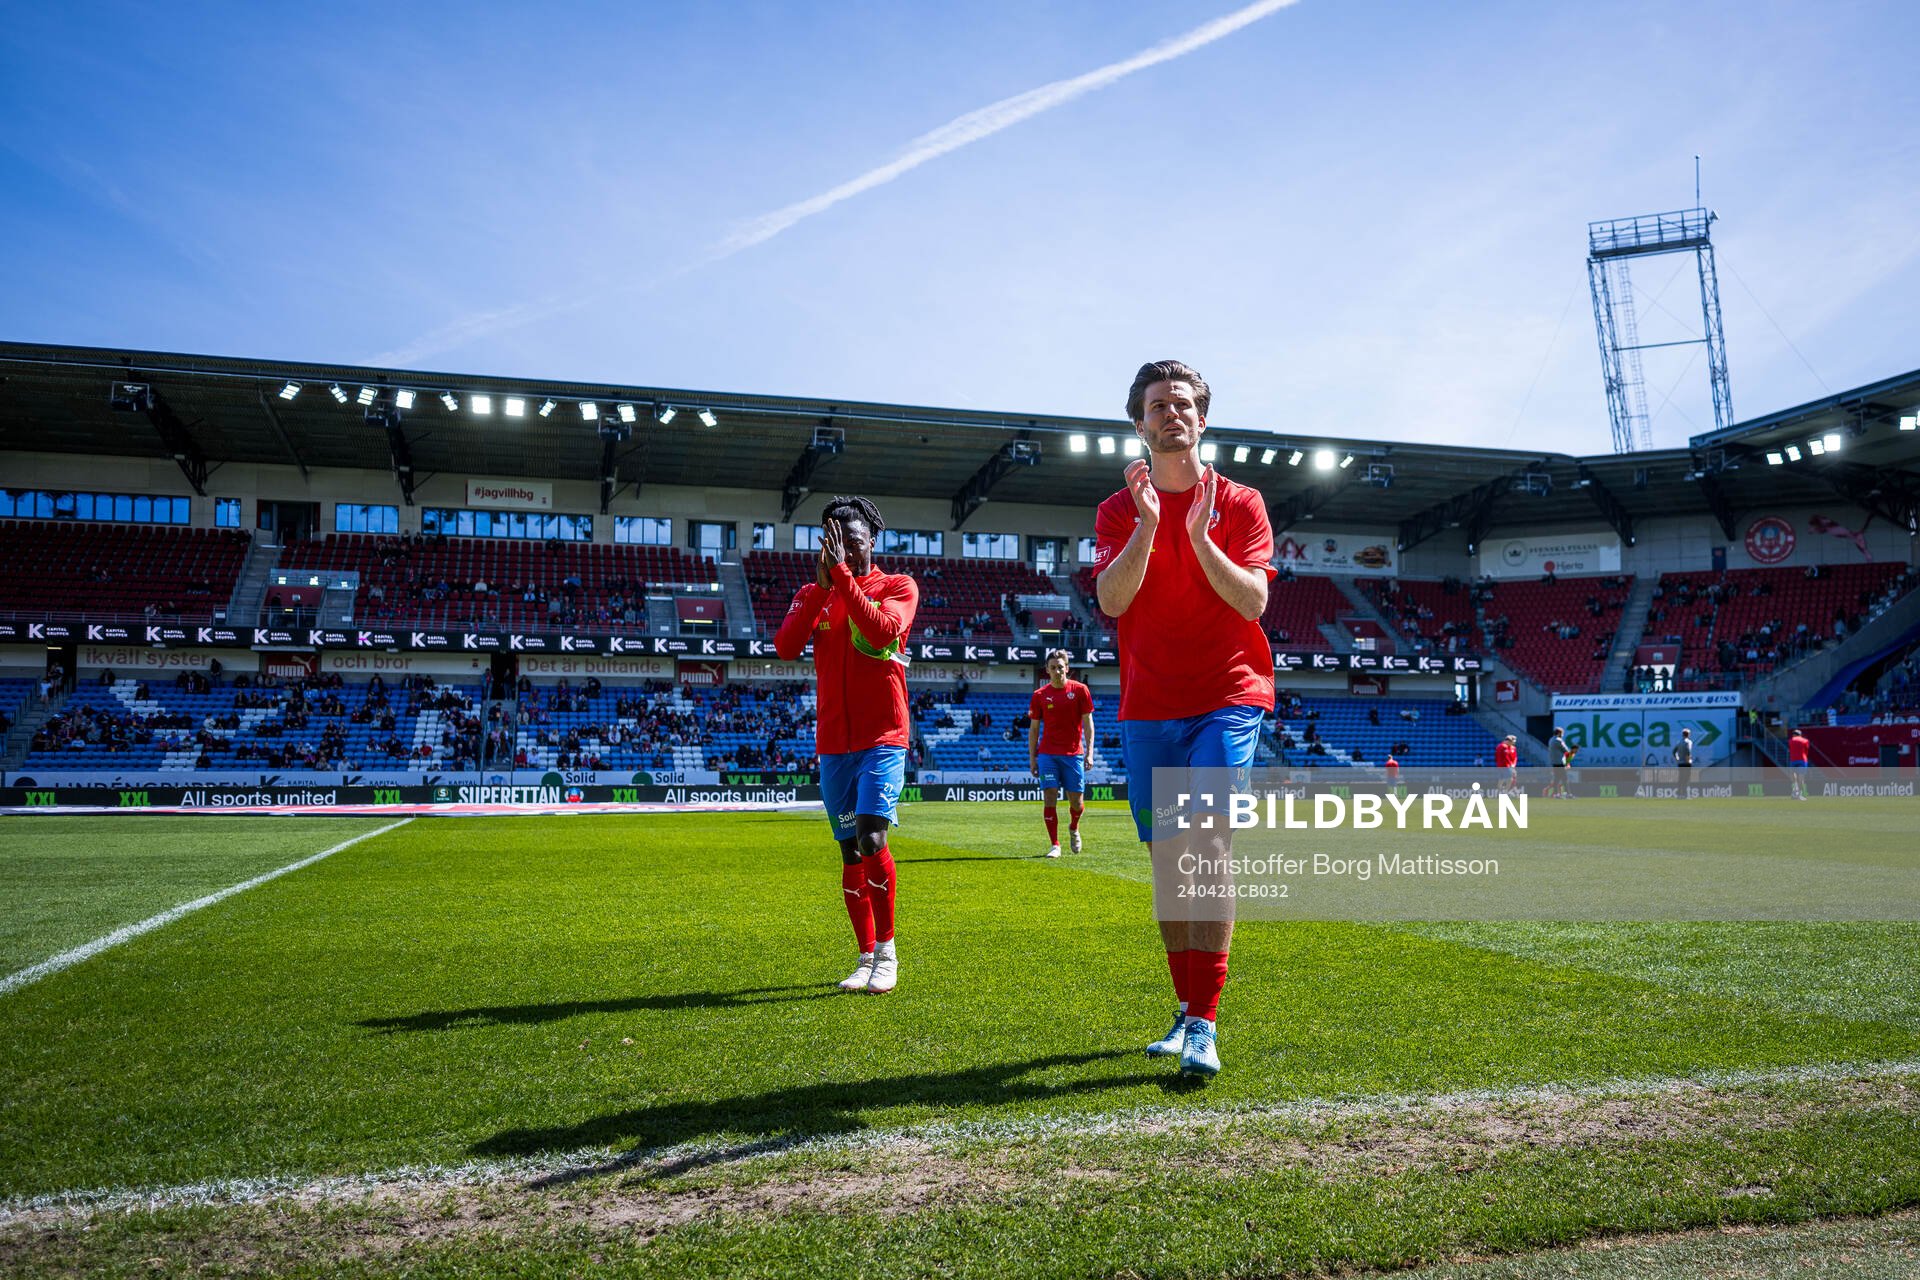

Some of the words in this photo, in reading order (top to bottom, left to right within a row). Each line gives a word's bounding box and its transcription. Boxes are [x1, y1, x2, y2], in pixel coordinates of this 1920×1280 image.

[475, 486, 534, 502] #jagvillhbg
[29, 624, 44, 638] K
[88, 625, 104, 640] K
[146, 626, 161, 641] K
[198, 627, 213, 642] K
[254, 629, 268, 643] K
[309, 630, 324, 645] K
[358, 631, 372, 646] K
[412, 632, 426, 647] K
[464, 634, 478, 648] K
[510, 635, 524, 649] K
[561, 636, 574, 650] K
[610, 637, 624, 652] K
[654, 638, 668, 652] K
[703, 640, 716, 654] K
[750, 640, 762, 654] K
[922, 645, 934, 658] K
[965, 646, 977, 659] K
[1008, 647, 1020, 660] K
[86, 648, 139, 664] ikväll
[146, 650, 208, 668] syster
[333, 654, 366, 669] och
[374, 655, 413, 670] bror
[1087, 648, 1099, 662] K
[1276, 654, 1287, 666] K
[1313, 654, 1324, 667] K
[1350, 655, 1361, 668] K
[1383, 656, 1394, 668] K
[527, 658, 556, 672] Det
[562, 659, 580, 673] är
[585, 659, 661, 673] bultande
[1419, 657, 1430, 669] K
[1454, 657, 1465, 670] K
[680, 672, 712, 683] PUMA
[1555, 698, 1610, 706] KLIPPANS
[1646, 696, 1703, 704] KLIPPANS
[1566, 714, 1671, 748] akea
[565, 772, 595, 783] Solid
[655, 772, 685, 783] Solid
[373, 789, 403, 804] XXL
[458, 786, 560, 804] SUPERETTAN
[613, 789, 639, 802] XXL
[665, 789, 685, 803] All
[690, 790, 741, 803] sports
[746, 788, 796, 802] united
[900, 788, 923, 801] XXL
[945, 788, 964, 801] All
[968, 789, 1014, 802] sports
[1091, 787, 1115, 800] XXL
[1600, 785, 1618, 797] XXL
[1702, 784, 1732, 797] united
[1822, 782, 1838, 796] All
[1840, 784, 1874, 797] sports
[1877, 782, 1914, 796] united
[25, 792, 57, 806] XXL
[119, 792, 151, 806] XXL
[181, 791, 205, 806] All
[212, 792, 272, 806] sports
[277, 790, 336, 806] united
[838, 810, 856, 823] Soli
